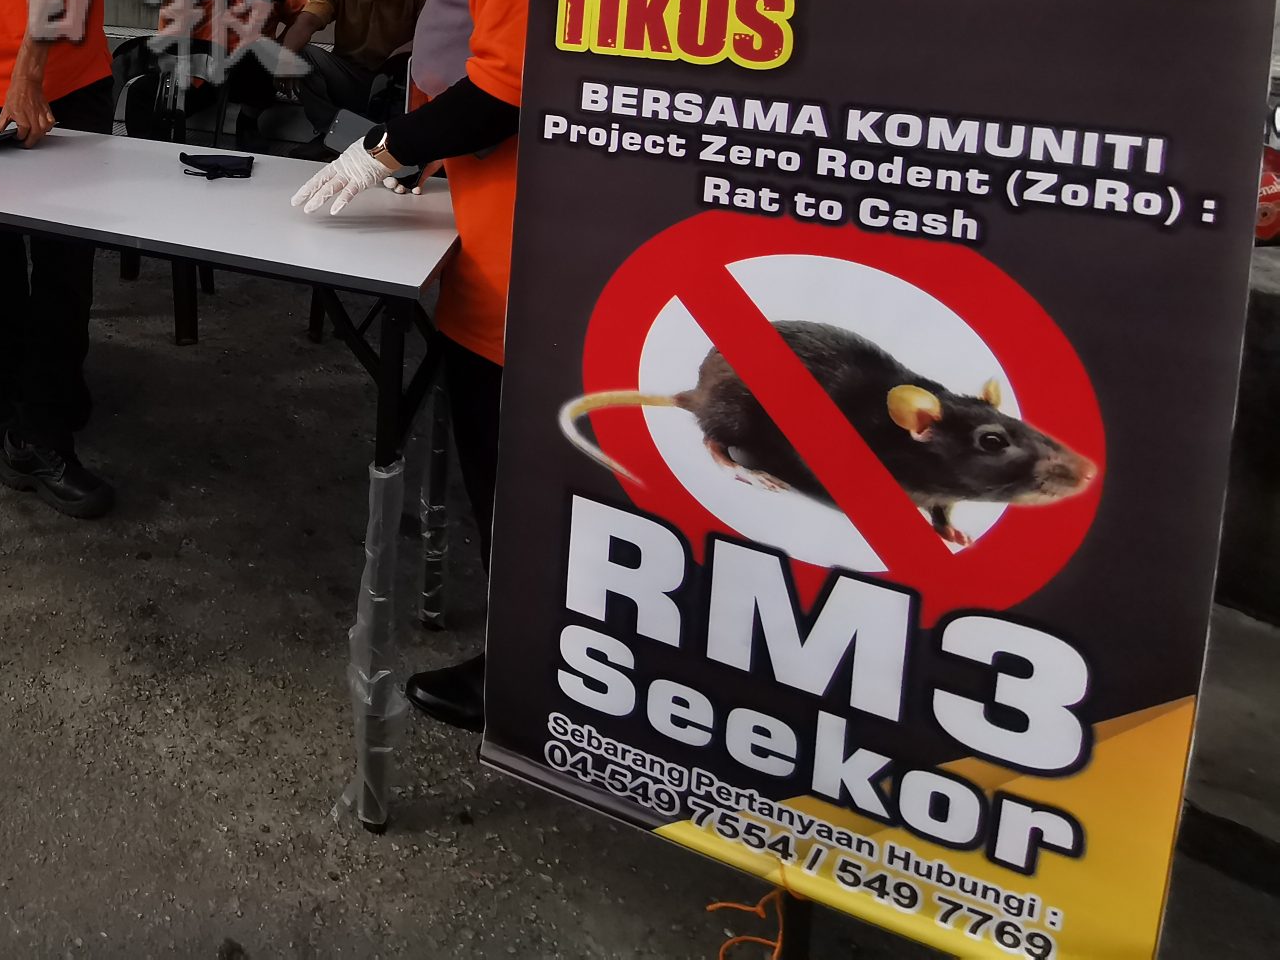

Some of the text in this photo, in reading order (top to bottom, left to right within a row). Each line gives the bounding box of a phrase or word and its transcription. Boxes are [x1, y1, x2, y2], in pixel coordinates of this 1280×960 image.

[543, 114, 687, 158] Project
[699, 134, 801, 173] Zero
[816, 147, 990, 196] Rodent
[1006, 169, 1181, 226] (ZoRo)
[580, 81, 1165, 174] BERSAMA KOMUNITI
[703, 176, 979, 241] Rat to Cash
[565, 494, 1089, 771] RM3
[549, 713, 687, 788] Sebarang
[693, 770, 876, 859] Pertanyaan
[886, 844, 1039, 919] Hubungi
[557, 624, 1084, 868] Seekor
[546, 742, 1053, 960] 04-549 7554 / 549 7769
